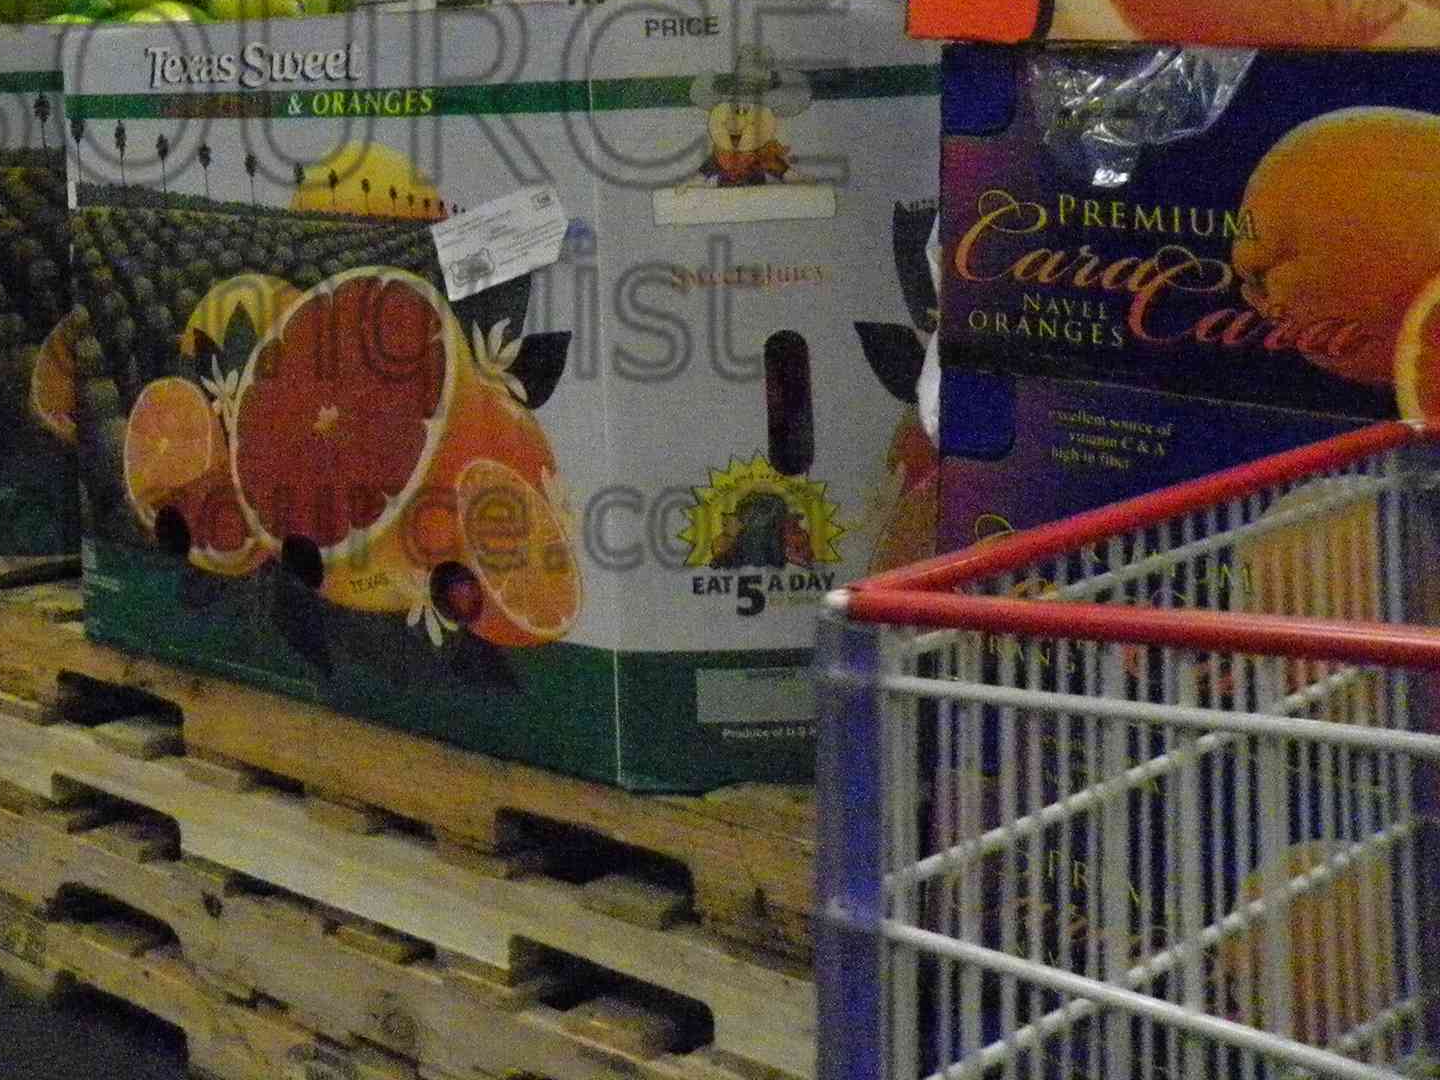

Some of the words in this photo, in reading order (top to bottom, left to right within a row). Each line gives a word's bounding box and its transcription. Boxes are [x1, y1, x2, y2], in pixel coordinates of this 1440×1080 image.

[643, 16, 720, 37] PRICE
[145, 46, 238, 89] Texas
[238, 34, 362, 88] Sweet
[287, 95, 303, 116] &
[312, 88, 434, 116] ORANGES
[1058, 193, 1260, 241] PREMIUM
[1022, 290, 1109, 321] NAVEL
[967, 309, 1125, 348] ORANGES
[692, 575, 734, 595] EAT
[736, 574, 766, 617] 5
[768, 573, 783, 592] A
[789, 571, 836, 592] DAY
